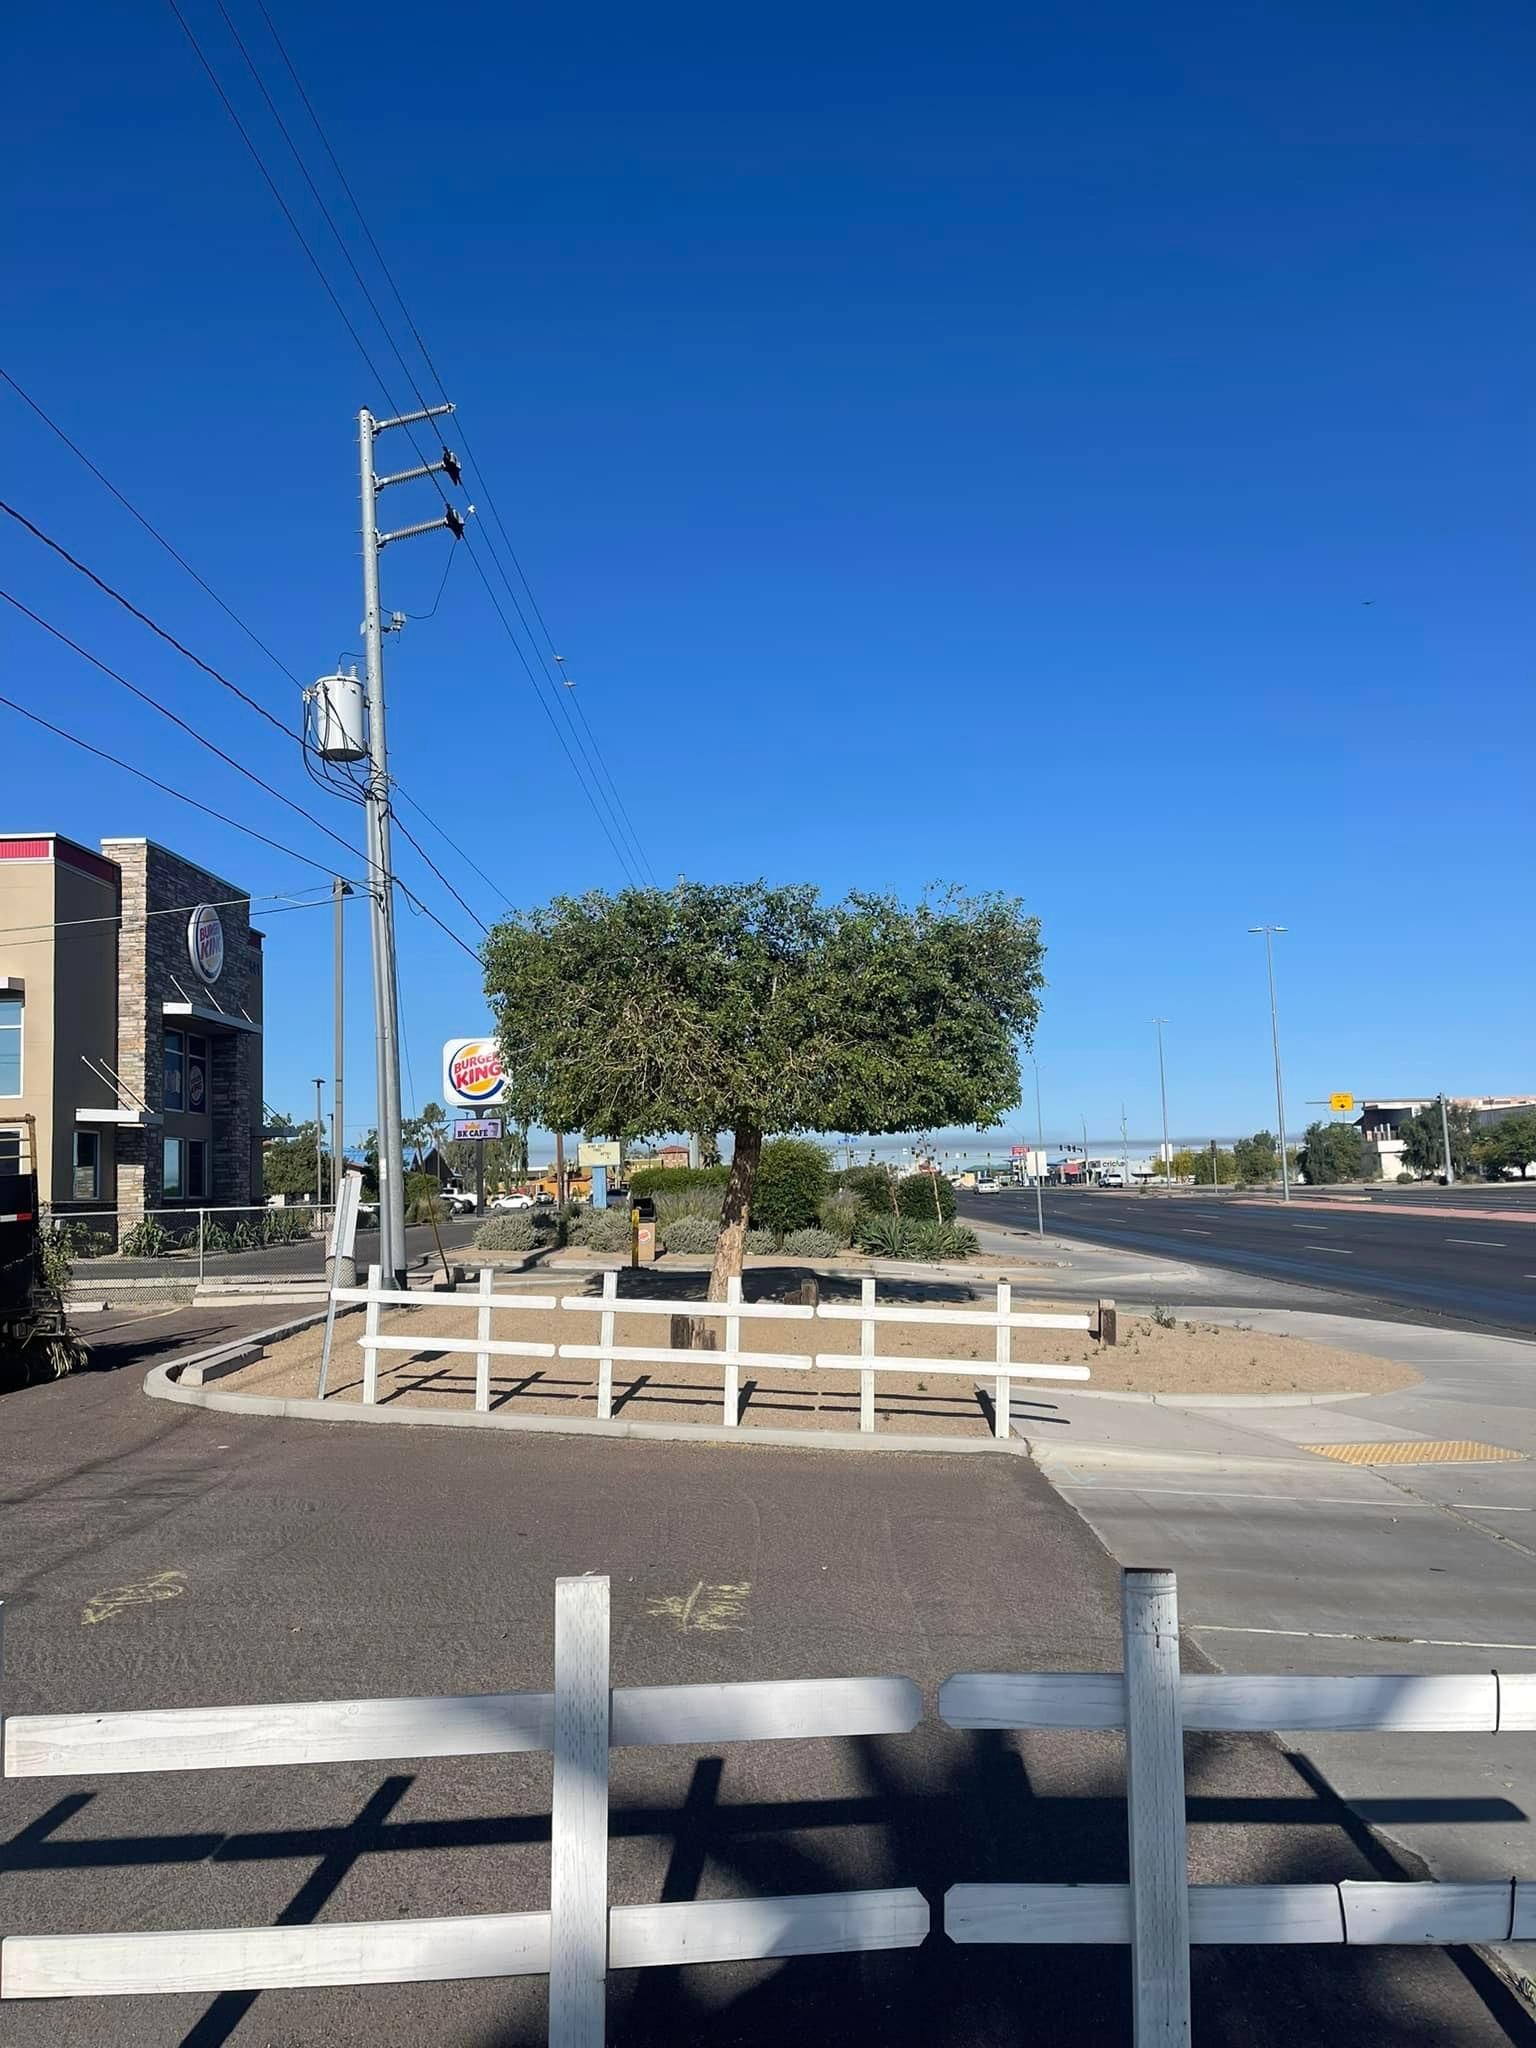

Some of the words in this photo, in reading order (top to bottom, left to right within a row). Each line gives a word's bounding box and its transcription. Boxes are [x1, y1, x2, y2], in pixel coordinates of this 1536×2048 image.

[454, 1051, 500, 1073] BURGER
[456, 1062, 502, 1089] KING
[457, 1130, 468, 1138] BK
